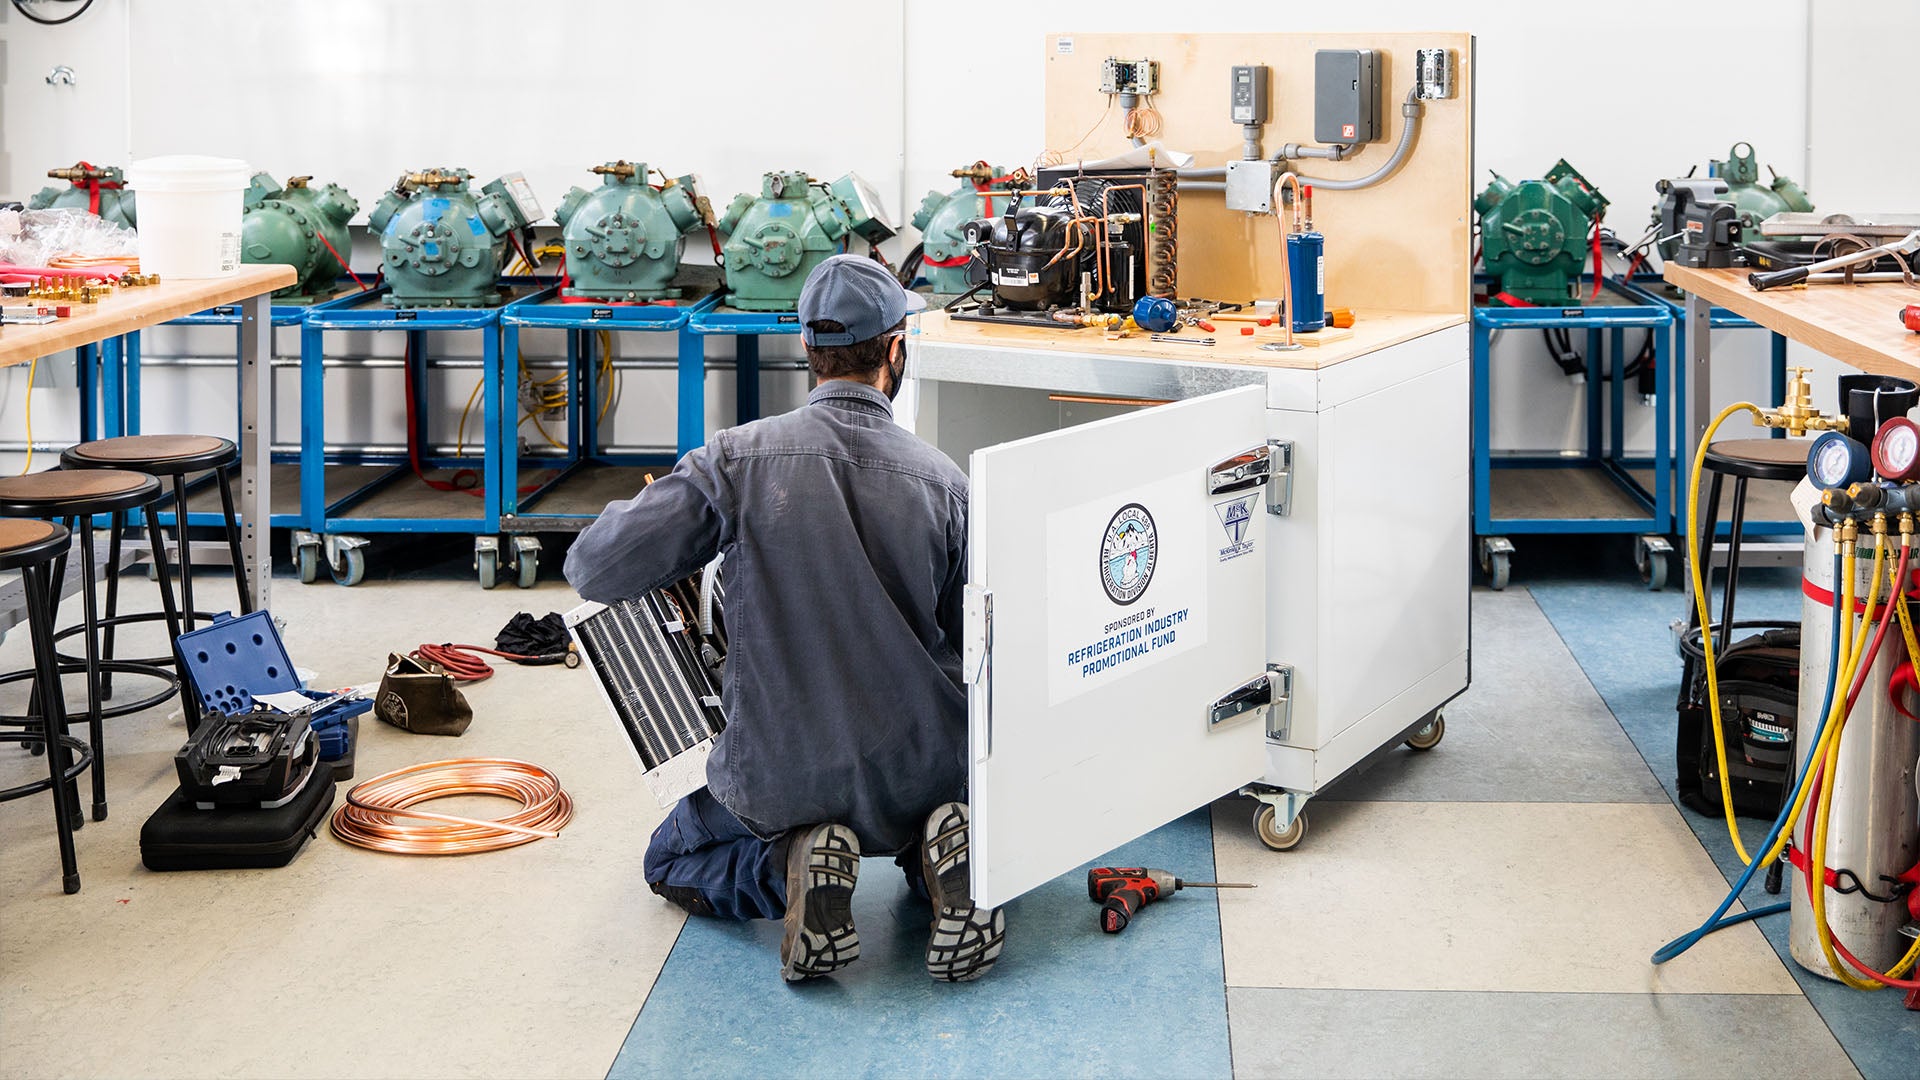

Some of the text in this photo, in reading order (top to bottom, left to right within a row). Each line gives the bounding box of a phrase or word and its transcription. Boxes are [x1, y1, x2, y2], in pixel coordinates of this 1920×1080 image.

[1118, 509, 1140, 524] LOCAL
[1103, 531, 1155, 600] REFRIGERATION DIVISION ALBERTA
[1068, 608, 1189, 666] REFRIGERATION INDUSTRY
[1104, 607, 1155, 634] SPONSORED BY
[1082, 630, 1176, 678] PROMOTIONAL FUND
